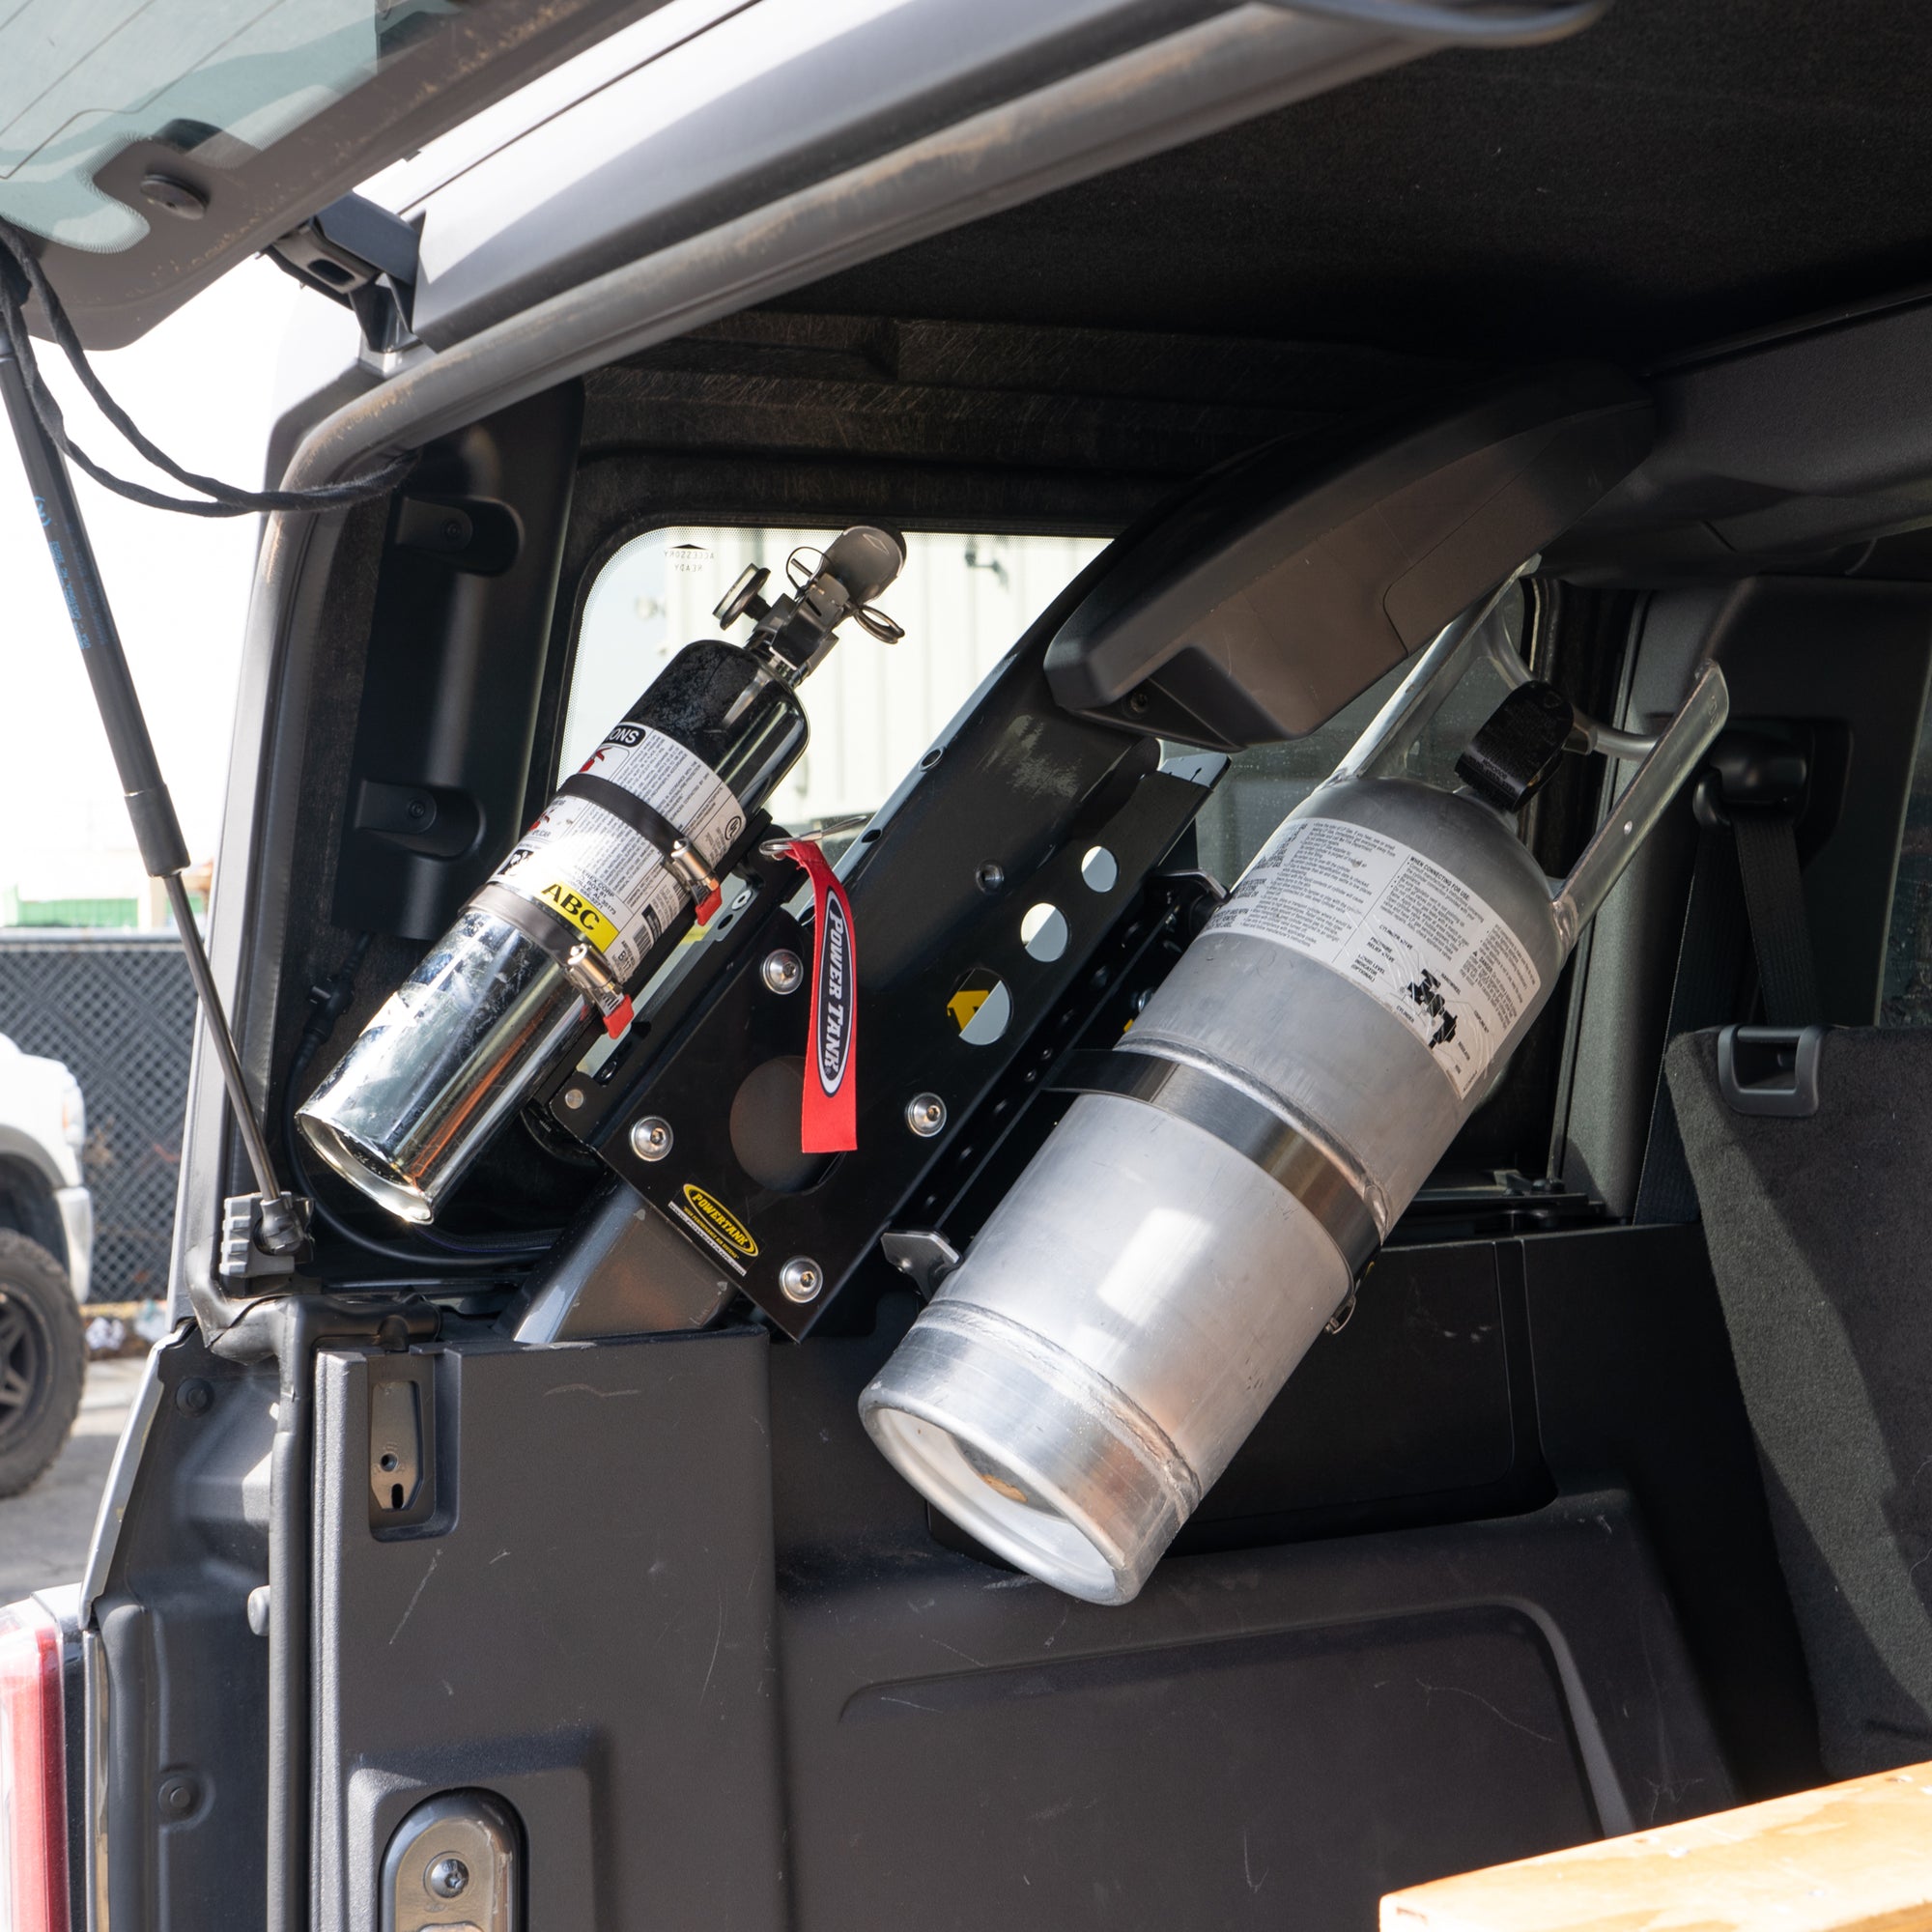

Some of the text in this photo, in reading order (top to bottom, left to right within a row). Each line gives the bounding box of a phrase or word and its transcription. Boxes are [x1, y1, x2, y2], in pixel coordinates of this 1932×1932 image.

[1410, 855, 1470, 901] WHEN CONNECTING FOR USE:
[541, 883, 600, 932] ABC
[824, 910, 842, 1072] POWER TANK
[691, 1192, 748, 1246] POWERTANK
